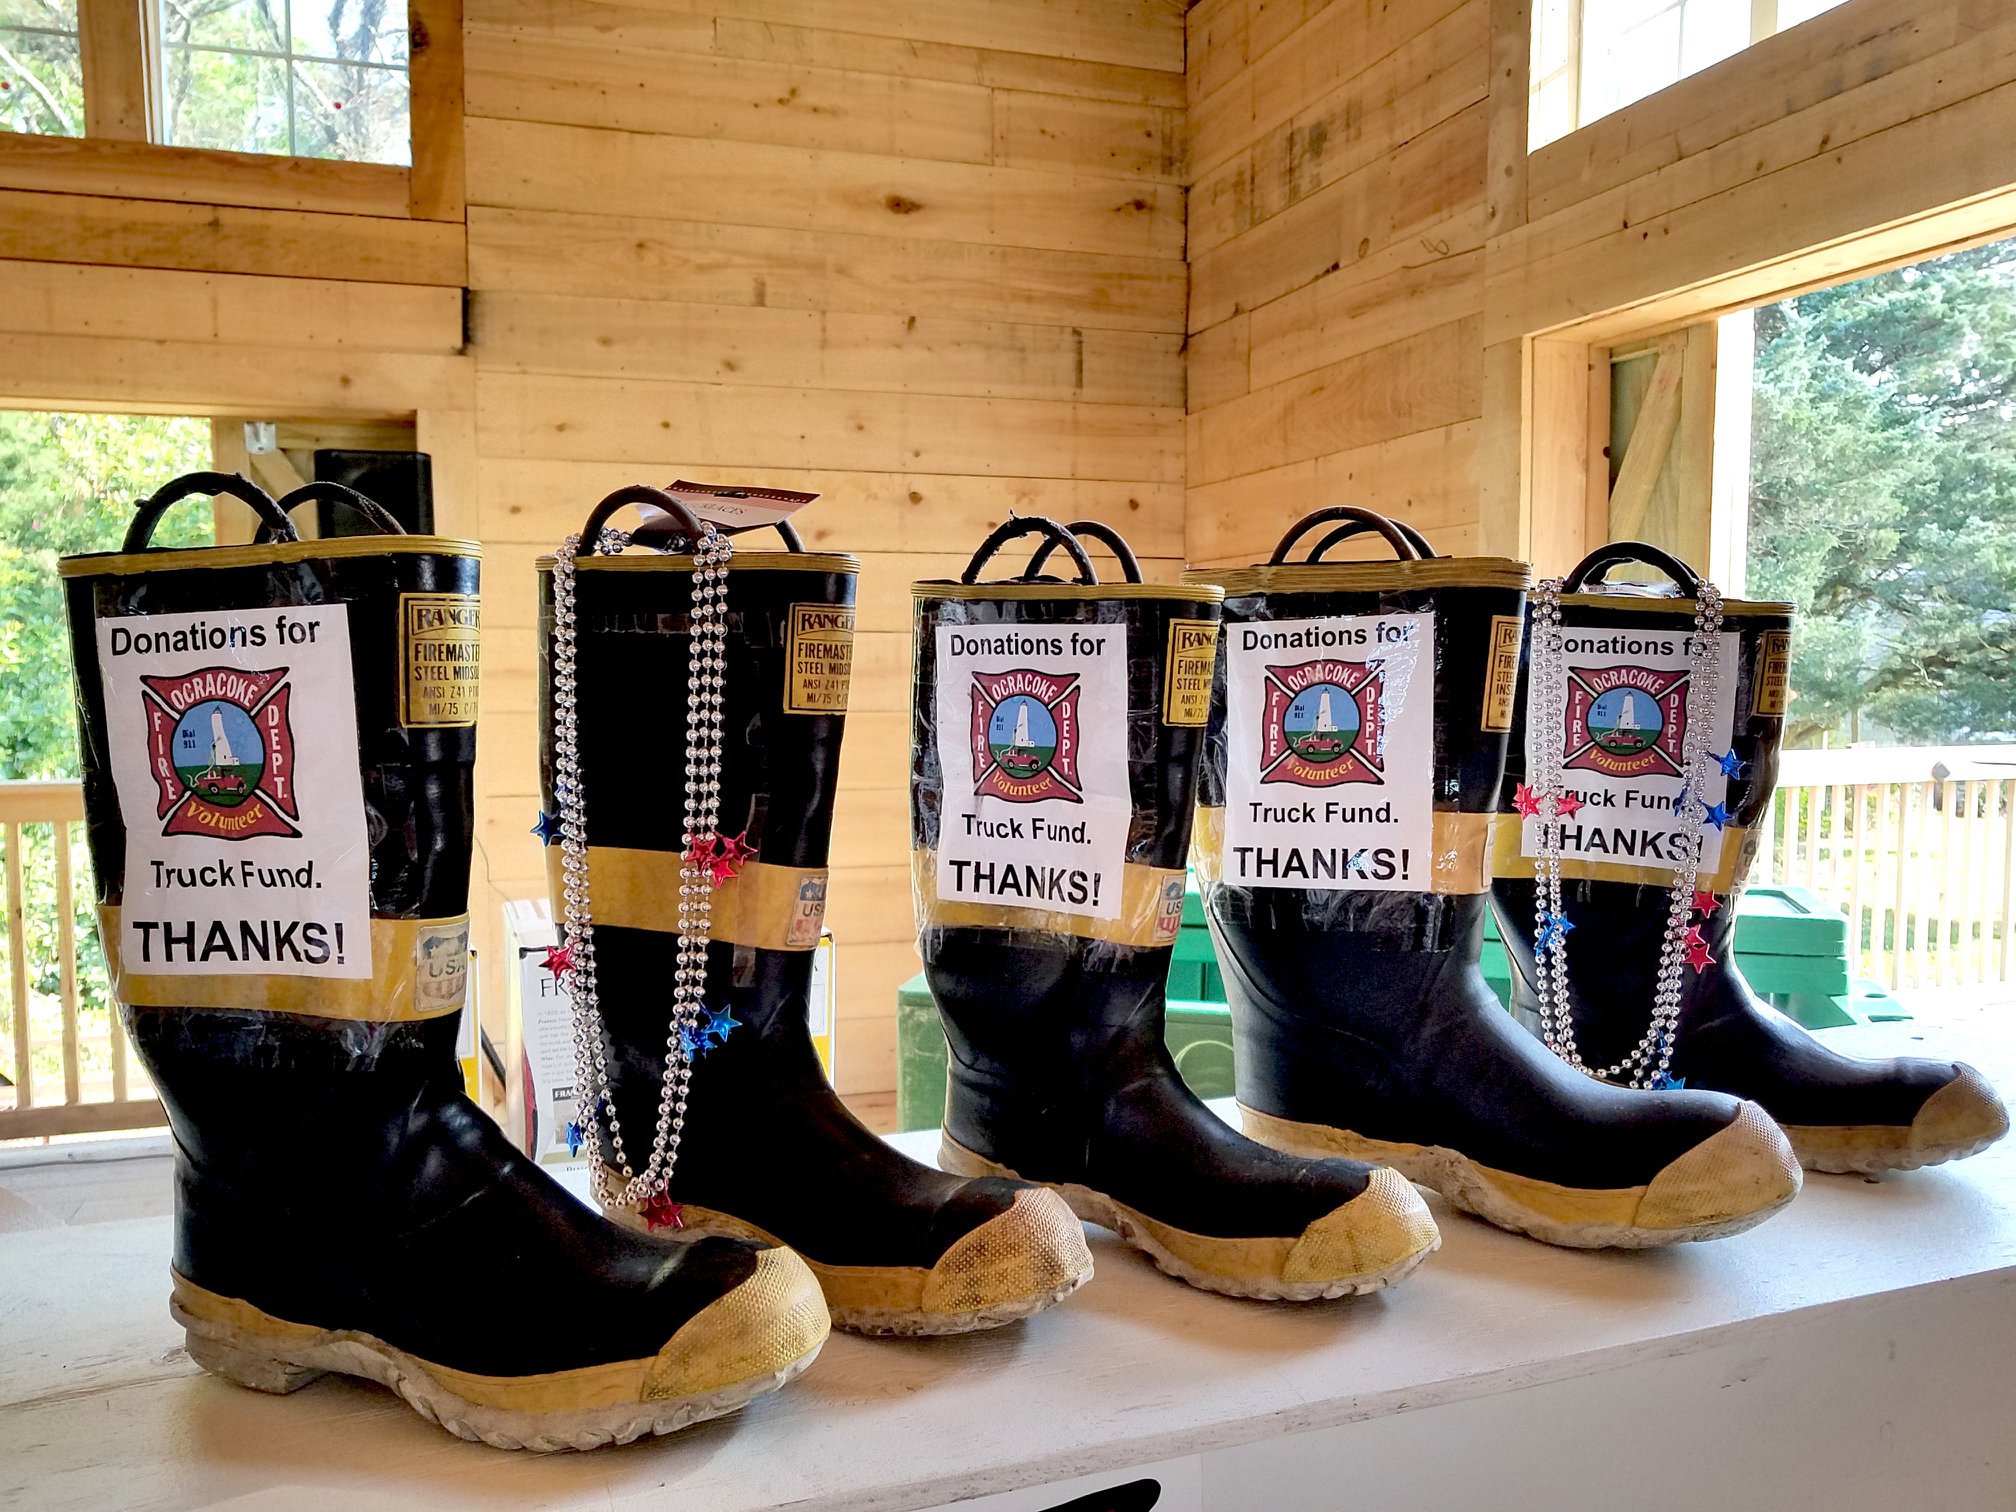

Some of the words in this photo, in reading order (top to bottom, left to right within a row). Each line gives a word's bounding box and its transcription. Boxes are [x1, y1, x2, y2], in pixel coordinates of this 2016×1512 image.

[111, 620, 266, 656] Donations
[276, 615, 320, 645] for
[951, 632, 1062, 656] Donations
[1070, 632, 1106, 656] for
[1243, 626, 1367, 650] Donations
[1376, 622, 1413, 643] for
[414, 666, 449, 680] STEEL
[797, 662, 825, 675] STEEL
[1287, 664, 1360, 691] OCRACOKE
[1593, 669, 1664, 693] OCRACOKE
[170, 672, 258, 710] OCRACOKE
[423, 686, 445, 698] ANSI
[803, 679, 820, 690] ANSI
[992, 674, 1057, 701] OCRACOKE
[1176, 678, 1201, 690] STEEL
[1269, 691, 1280, 756] FIRE
[1365, 687, 1376, 756] DEPT.
[1573, 691, 1583, 746] FIRE
[1668, 693, 1679, 753] DEPT.
[977, 701, 986, 768] FIRE
[1062, 702, 1072, 775] DEPT.
[153, 712, 177, 800] FIRE
[267, 705, 287, 799] DEPT.
[1589, 749, 1656, 771] Volunteer
[992, 772, 1053, 796] Volunteer
[1286, 759, 1354, 780] Volunteer
[186, 801, 264, 831] Volunteer
[1249, 802, 1316, 823] Truck
[1325, 802, 1399, 823] Fund.
[962, 813, 1024, 839] Truck
[1032, 818, 1091, 844] Fund.
[150, 859, 236, 889] Truck
[240, 860, 322, 889] Fund.
[1233, 847, 1409, 881] THANKS!
[949, 860, 1101, 906] THANKS!
[132, 920, 345, 965] THANKS!
